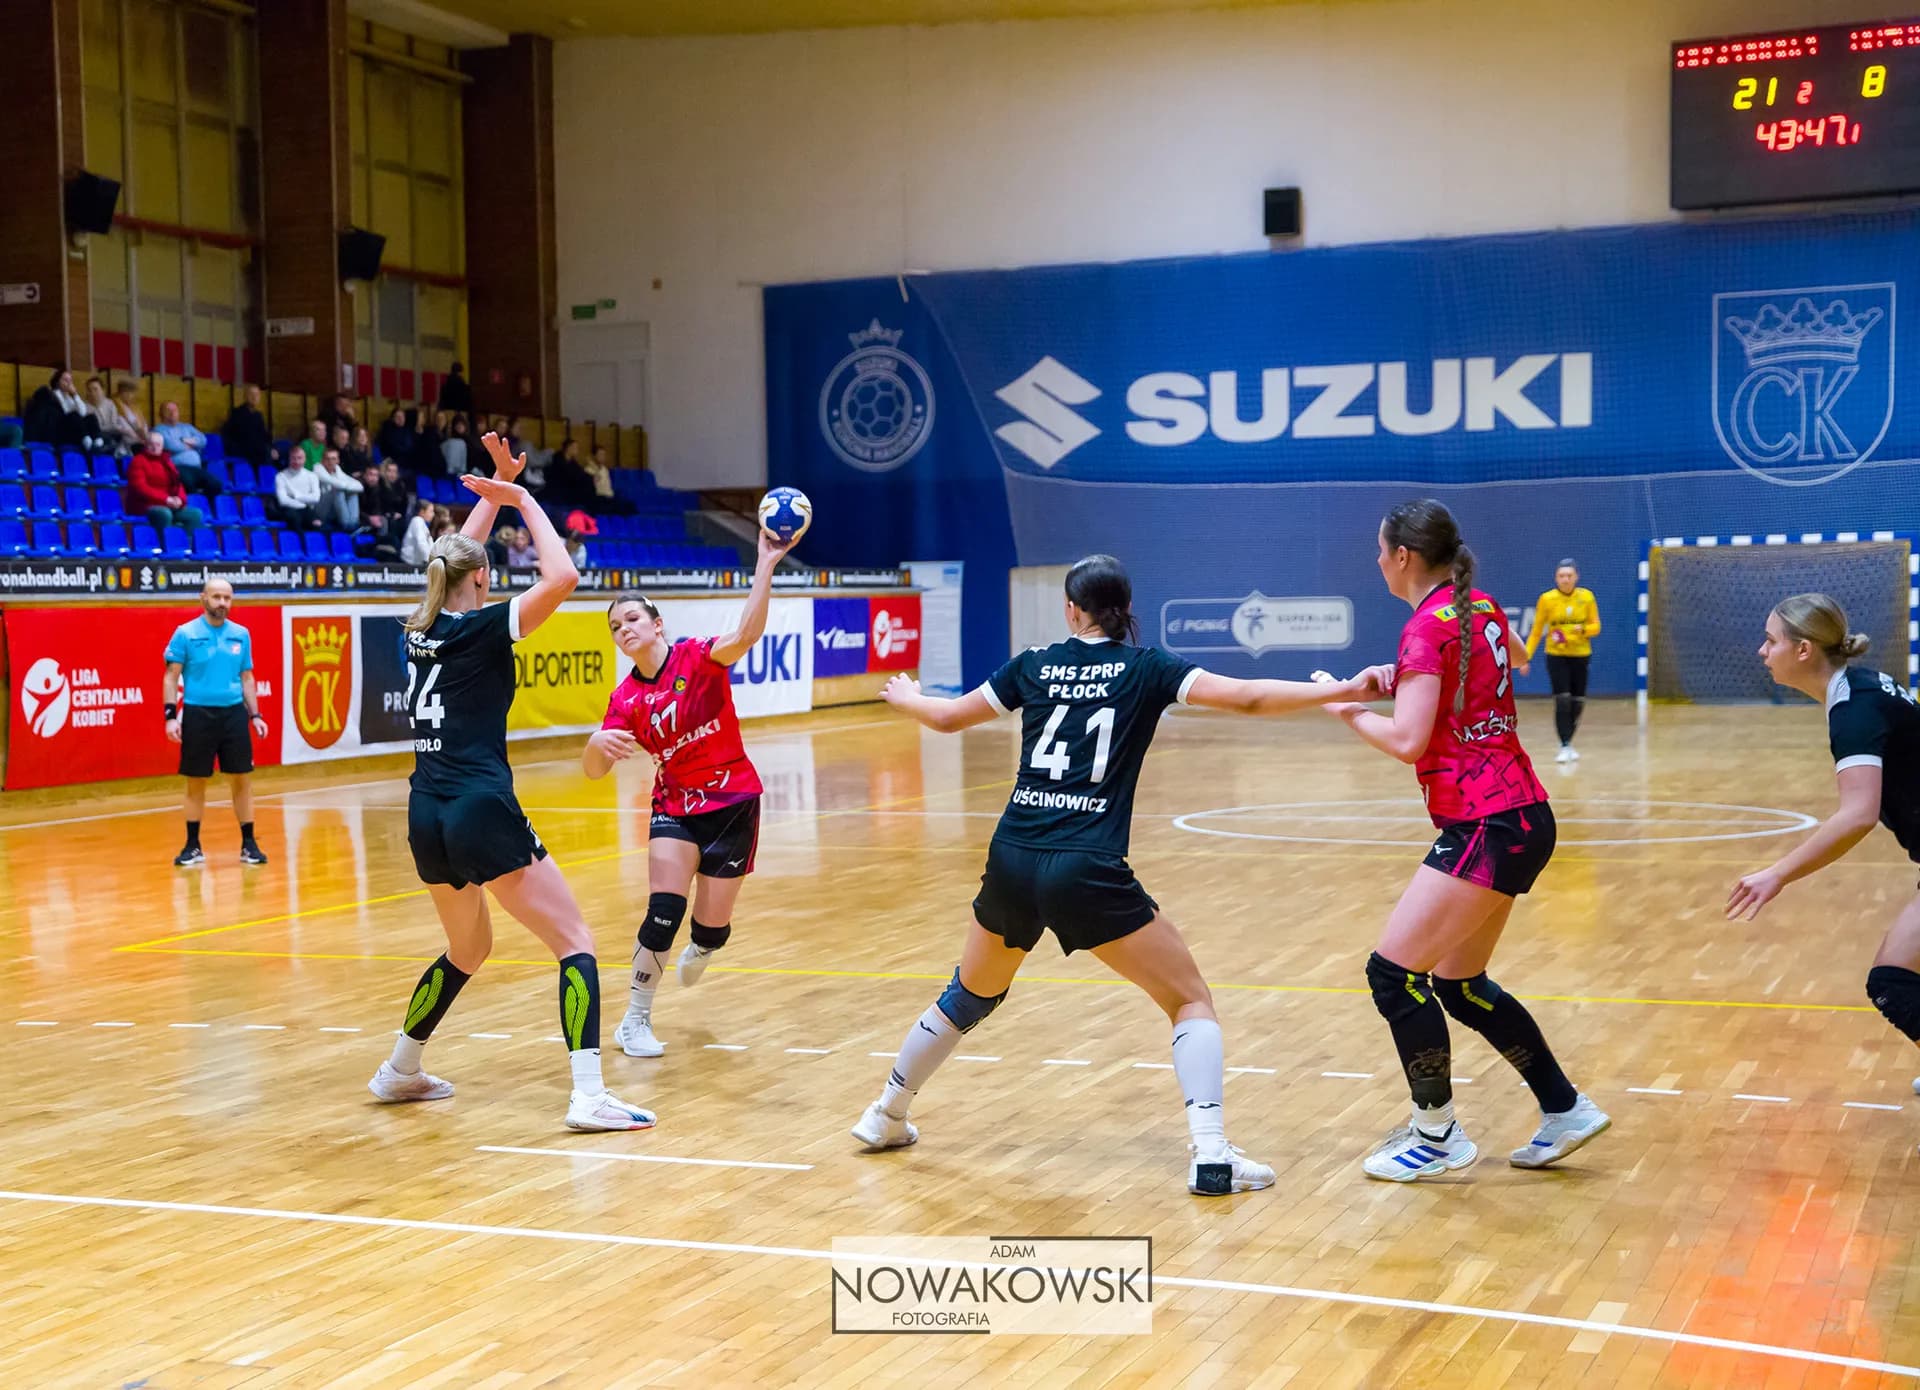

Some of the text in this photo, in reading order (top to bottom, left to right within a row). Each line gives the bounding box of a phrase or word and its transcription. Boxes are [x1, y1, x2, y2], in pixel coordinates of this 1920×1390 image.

[1732, 65, 1887, 110] 21 2 8
[1125, 352, 1593, 446] SUZUKI
[1730, 365, 1860, 463] CK
[0, 566, 102, 592] onahandball.pl
[72, 668, 101, 687] LIGA
[513, 650, 604, 689] OLPORTER
[1039, 662, 1126, 681] SMS ZPRP
[72, 686, 144, 708] CENTRALNA
[298, 669, 342, 734] CK
[1048, 683, 1110, 699] PŁOCK
[72, 707, 116, 729] KOBIET
[662, 718, 721, 761] SZUKI
[1029, 704, 1116, 783] 41
[1012, 786, 1107, 813] UŚCINOWICZ
